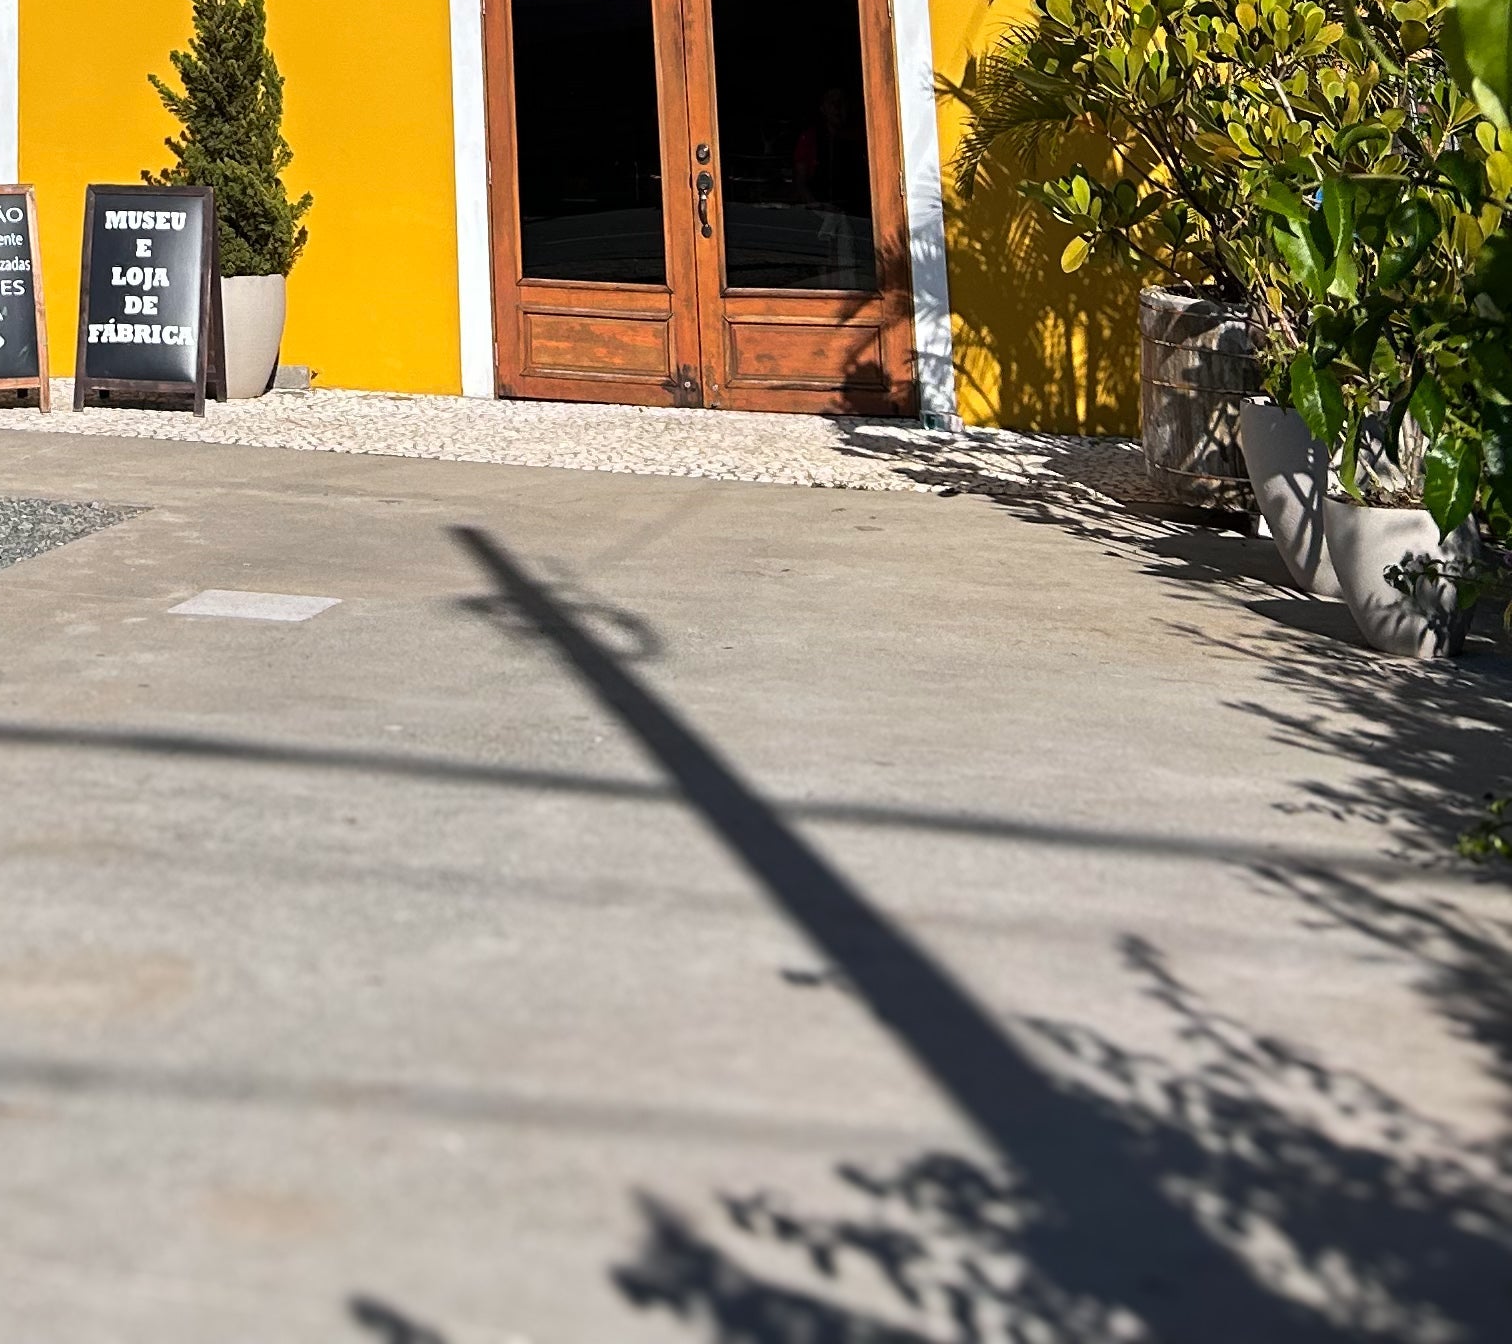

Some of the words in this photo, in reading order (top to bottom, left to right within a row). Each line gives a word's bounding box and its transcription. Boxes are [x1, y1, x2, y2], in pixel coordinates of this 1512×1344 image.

[104, 210, 187, 231] MUSEU
[135, 238, 152, 257] E
[111, 266, 170, 291] LOJA
[124, 295, 159, 315] DE
[87, 317, 196, 346] FÁBRICA
